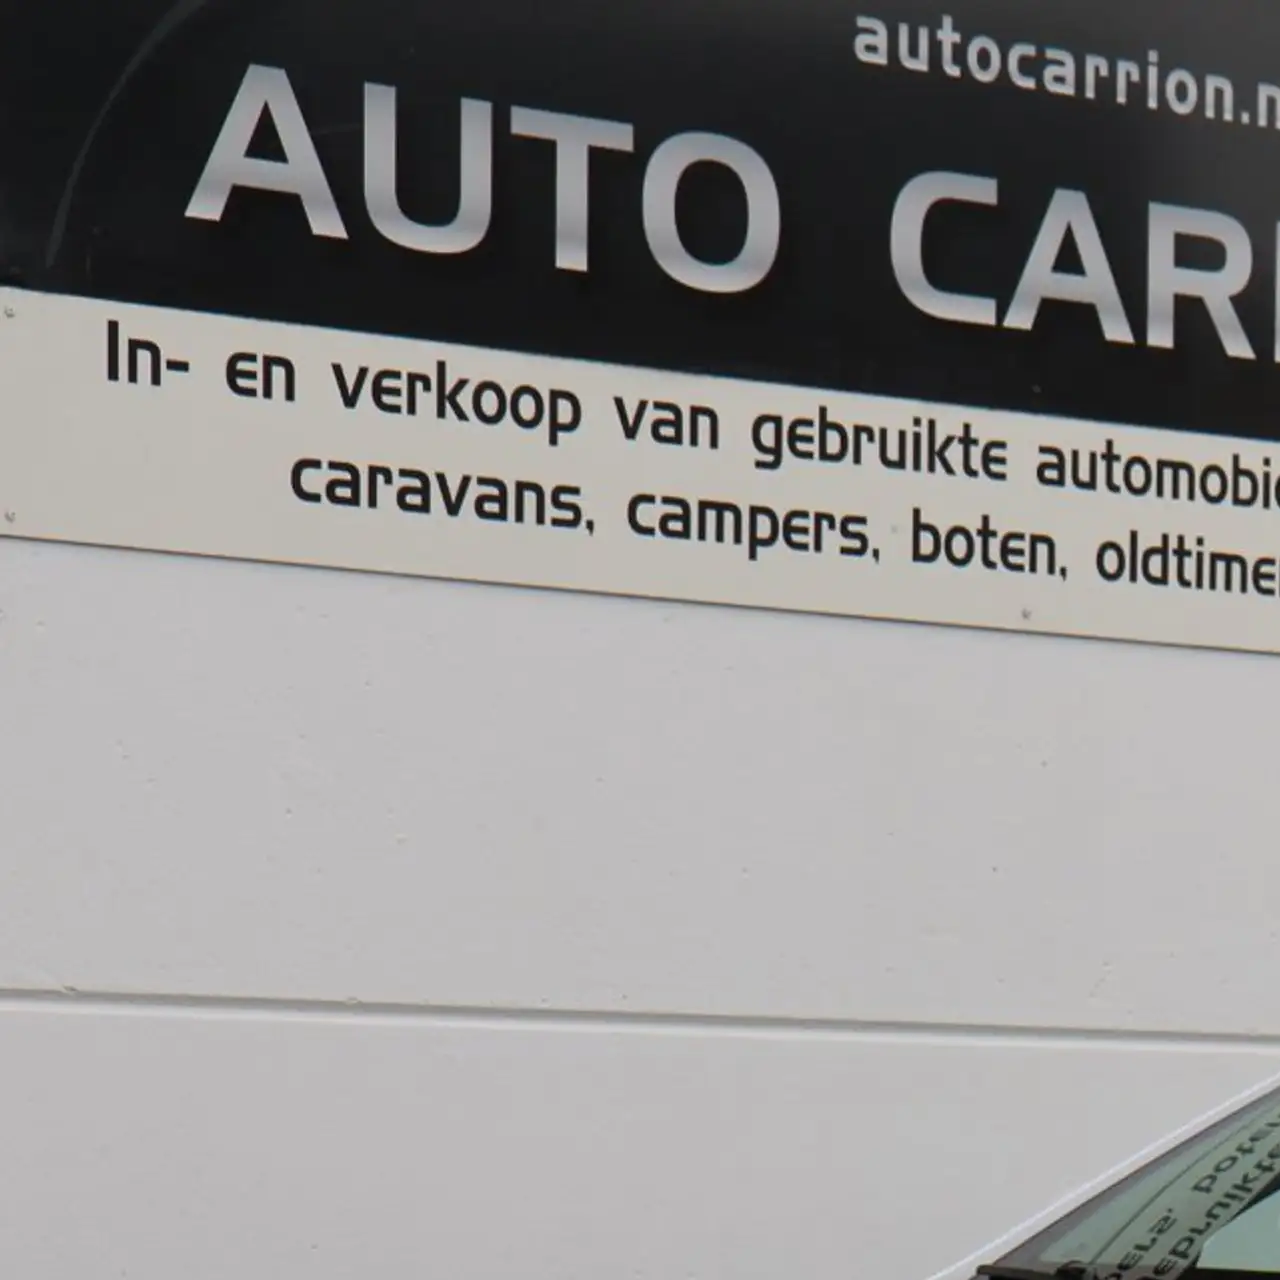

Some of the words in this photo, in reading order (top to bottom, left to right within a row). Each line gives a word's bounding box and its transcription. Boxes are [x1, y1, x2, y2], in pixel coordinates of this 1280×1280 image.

[184, 63, 781, 294] AUTO
[106, 318, 191, 388] In-
[224, 351, 296, 402] en
[331, 360, 583, 447] verkoop
[612, 395, 720, 450] van
[750, 405, 1008, 482] gebruikte
[289, 457, 597, 536] caravans,
[626, 492, 882, 563] campers,
[911, 507, 1069, 581] boten,
